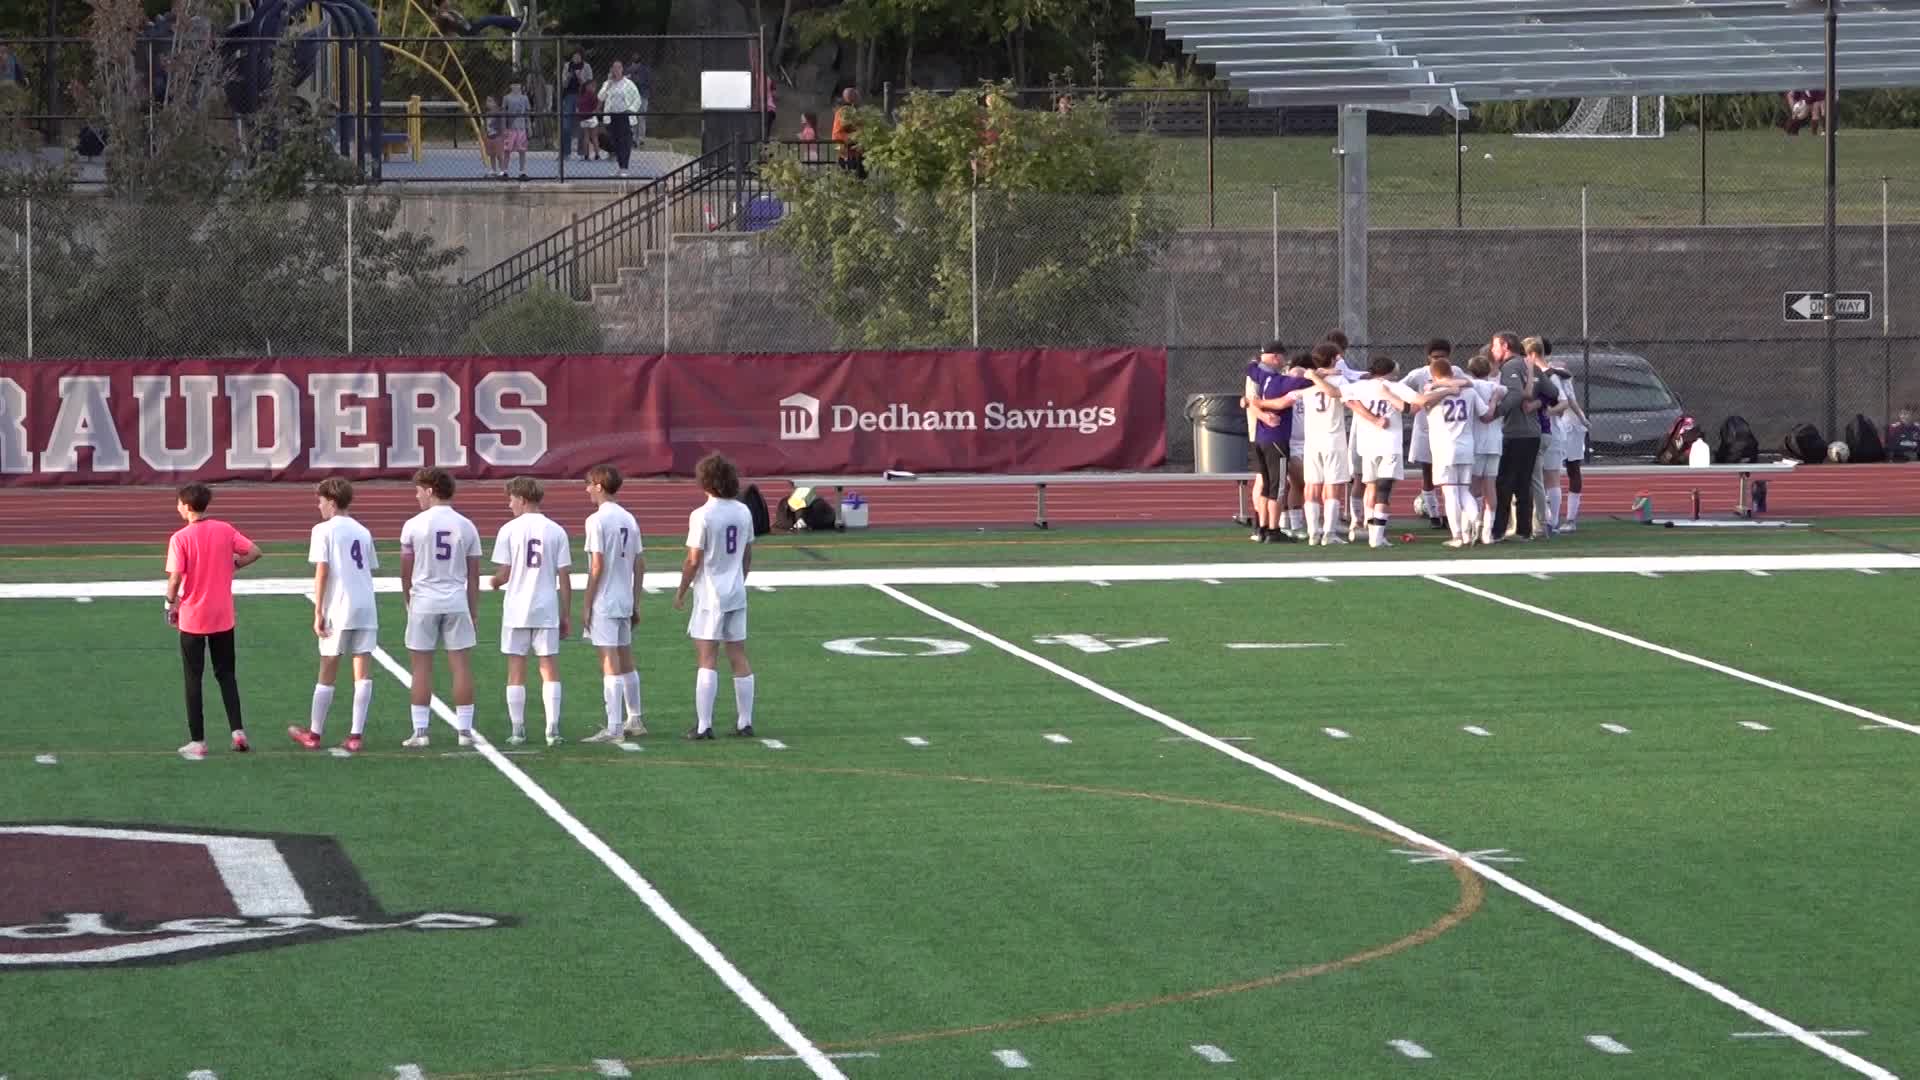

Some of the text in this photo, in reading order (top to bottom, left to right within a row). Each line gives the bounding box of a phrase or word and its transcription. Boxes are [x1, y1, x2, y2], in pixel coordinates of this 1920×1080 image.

[1810, 301, 1830, 312] ON
[831, 401, 1116, 434] Dedham Savings
[1443, 399, 1467, 422] 23
[350, 539, 364, 569] 4
[435, 531, 452, 561] 5
[526, 539, 542, 569] 6
[726, 525, 738, 555] 8
